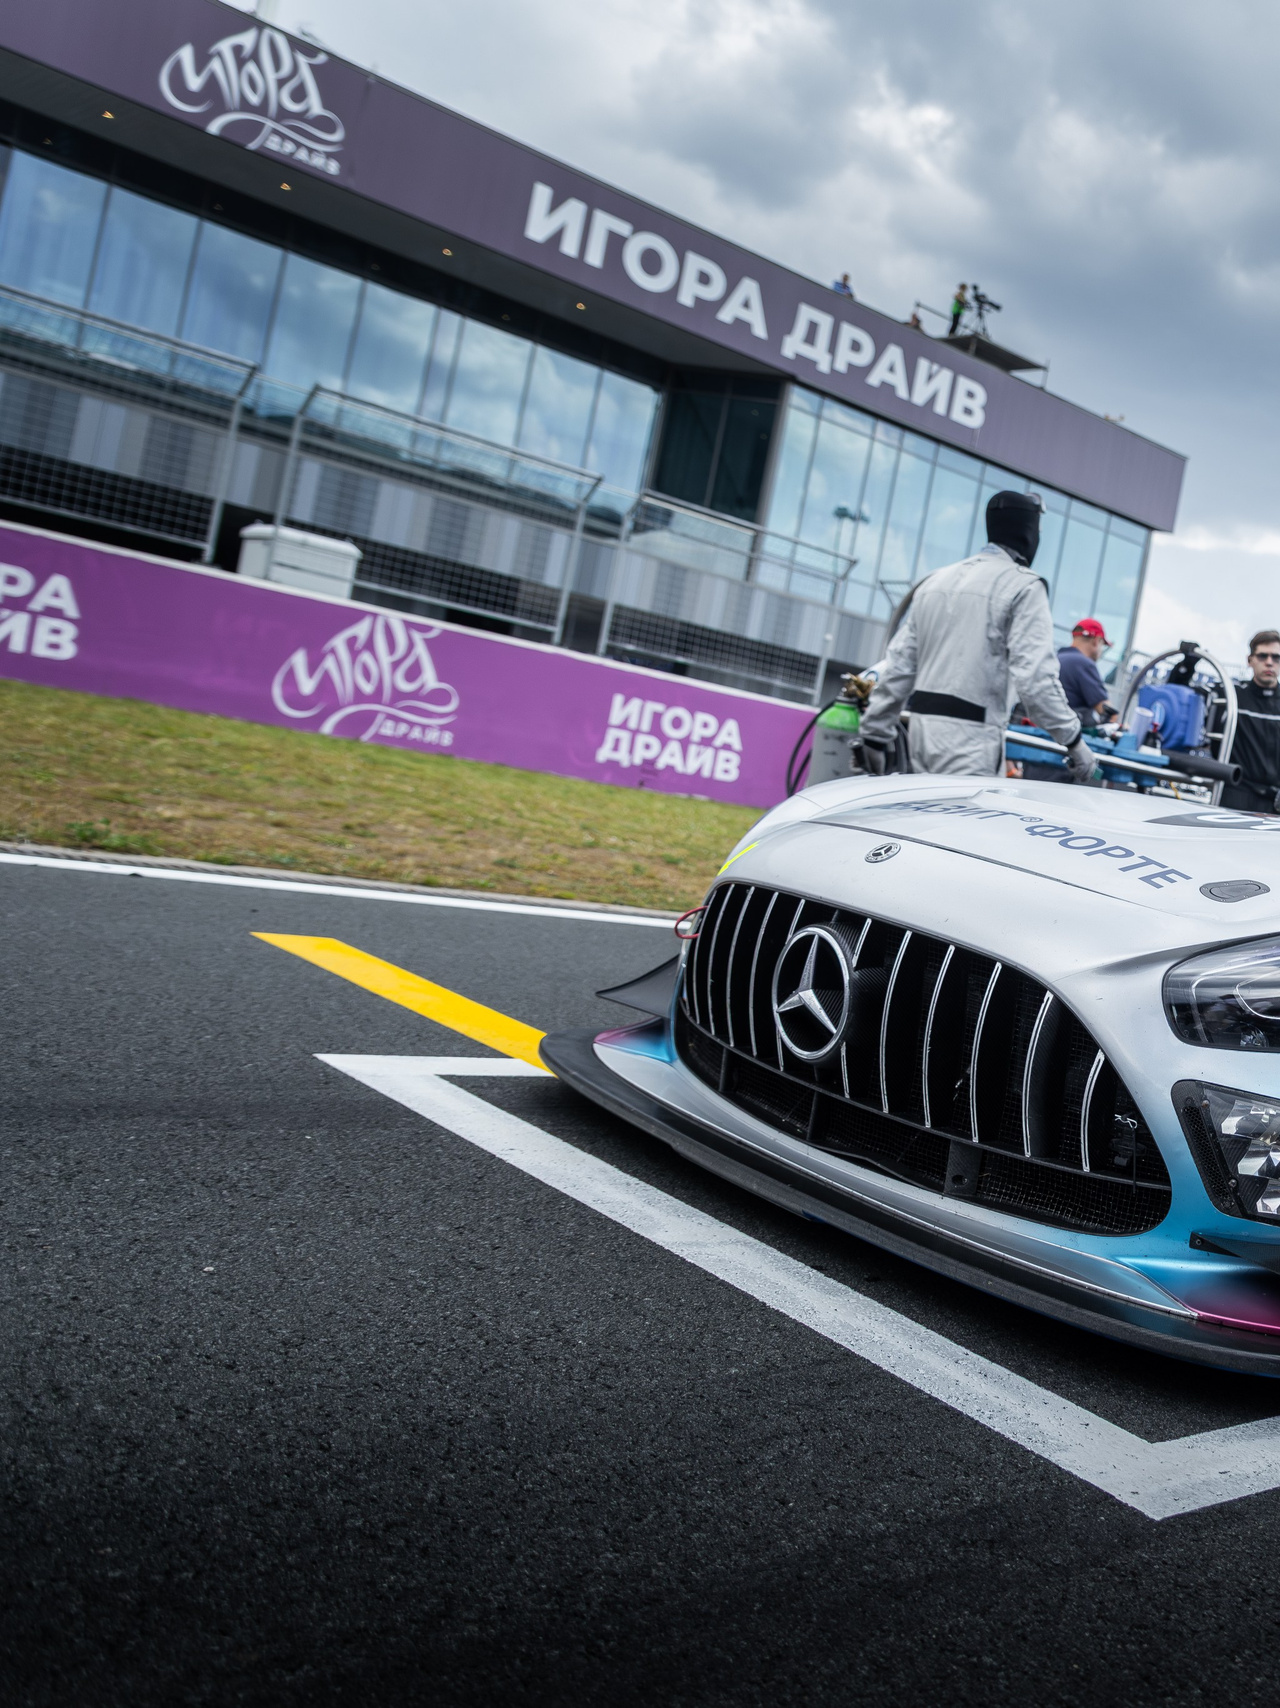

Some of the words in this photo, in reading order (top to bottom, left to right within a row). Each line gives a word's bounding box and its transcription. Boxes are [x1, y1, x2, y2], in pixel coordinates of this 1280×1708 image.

[524, 181, 768, 340] ИГОРА
[781, 302, 988, 429] ДРАЙВ
[0, 562, 82, 619] РА
[377, 718, 455, 747] ДРАЙВ
[607, 693, 743, 751] ИГОРА
[595, 726, 742, 782] ДРАЙВ
[1024, 824, 1193, 889] ФОРТЕ
